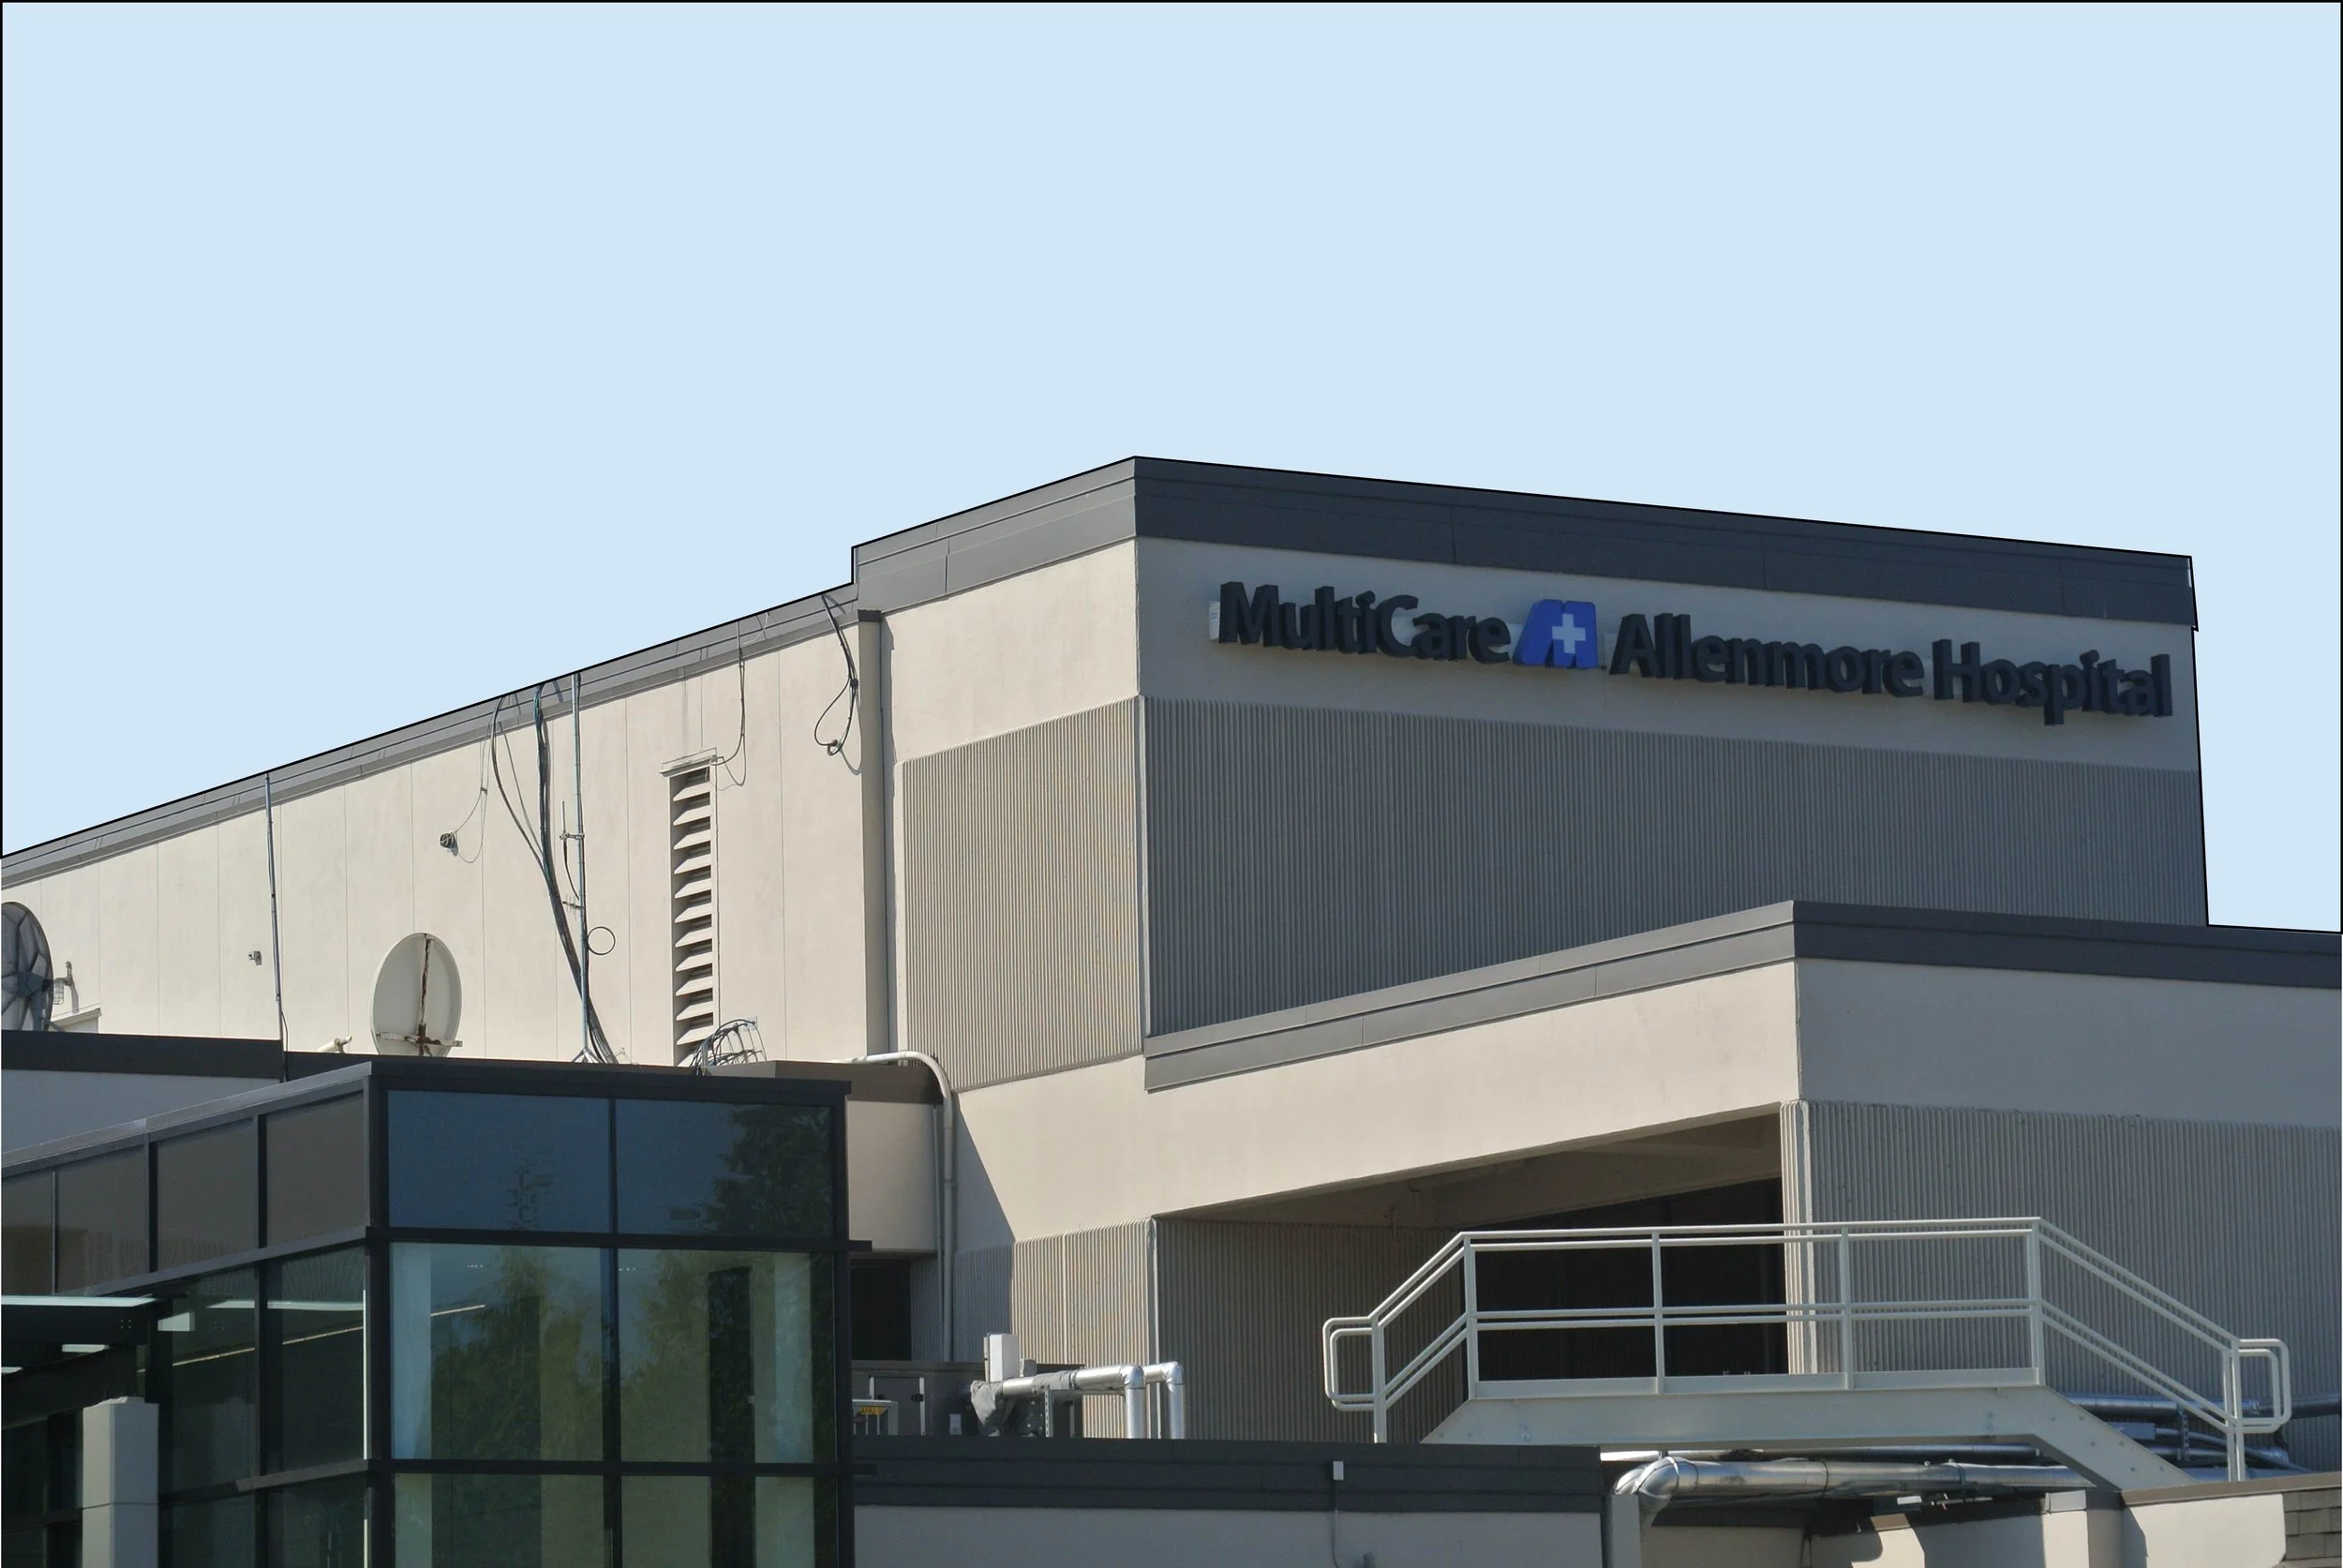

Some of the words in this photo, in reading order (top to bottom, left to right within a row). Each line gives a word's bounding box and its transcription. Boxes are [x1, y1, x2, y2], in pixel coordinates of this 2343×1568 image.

[1219, 581, 1511, 664] MultiCare
[1609, 613, 1924, 697] Allenmore
[1933, 638, 2172, 725] Hospital
